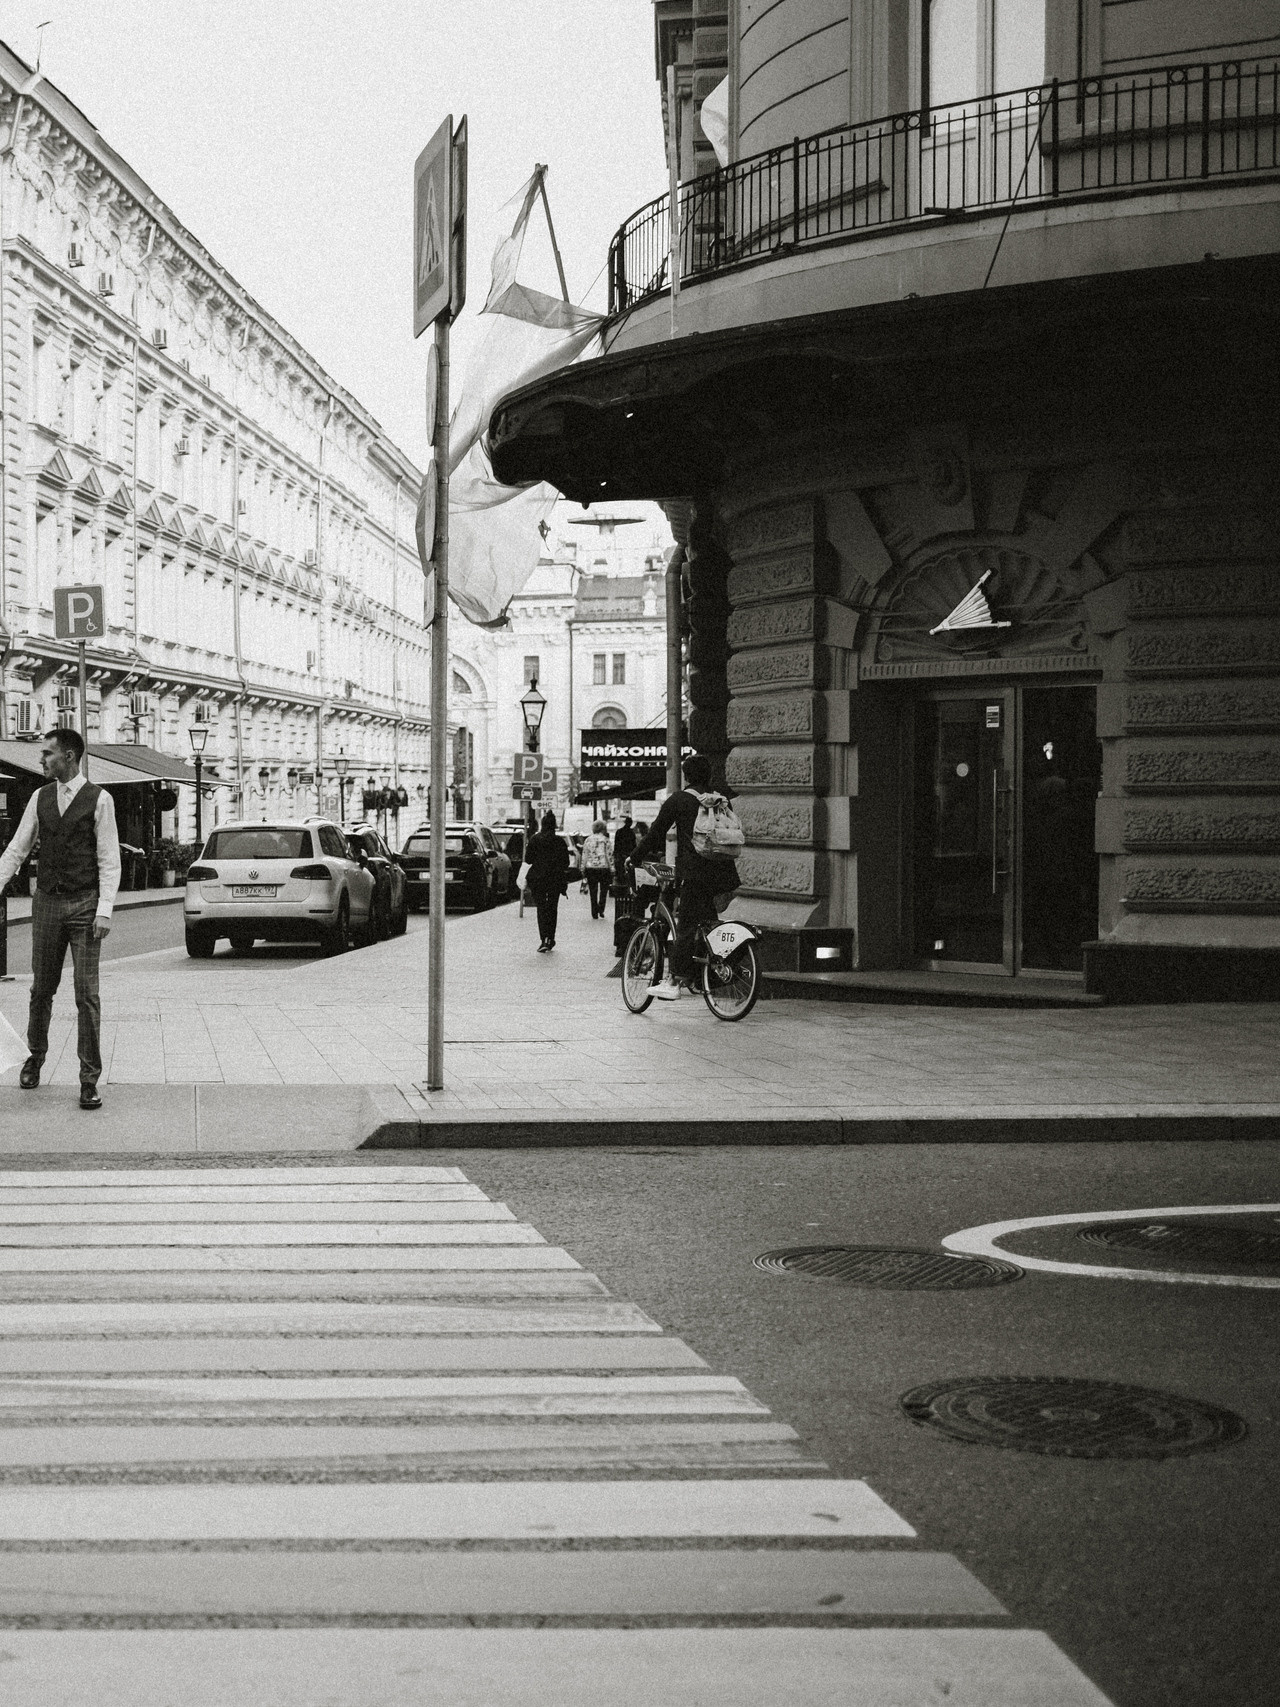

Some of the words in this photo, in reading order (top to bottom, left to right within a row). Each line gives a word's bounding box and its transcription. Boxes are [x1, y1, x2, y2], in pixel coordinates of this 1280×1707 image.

[68, 592, 95, 634] P
[581, 744, 667, 757] ЧАЙХОНА
[521, 755, 539, 780] P
[721, 932, 735, 943] ВТБ
